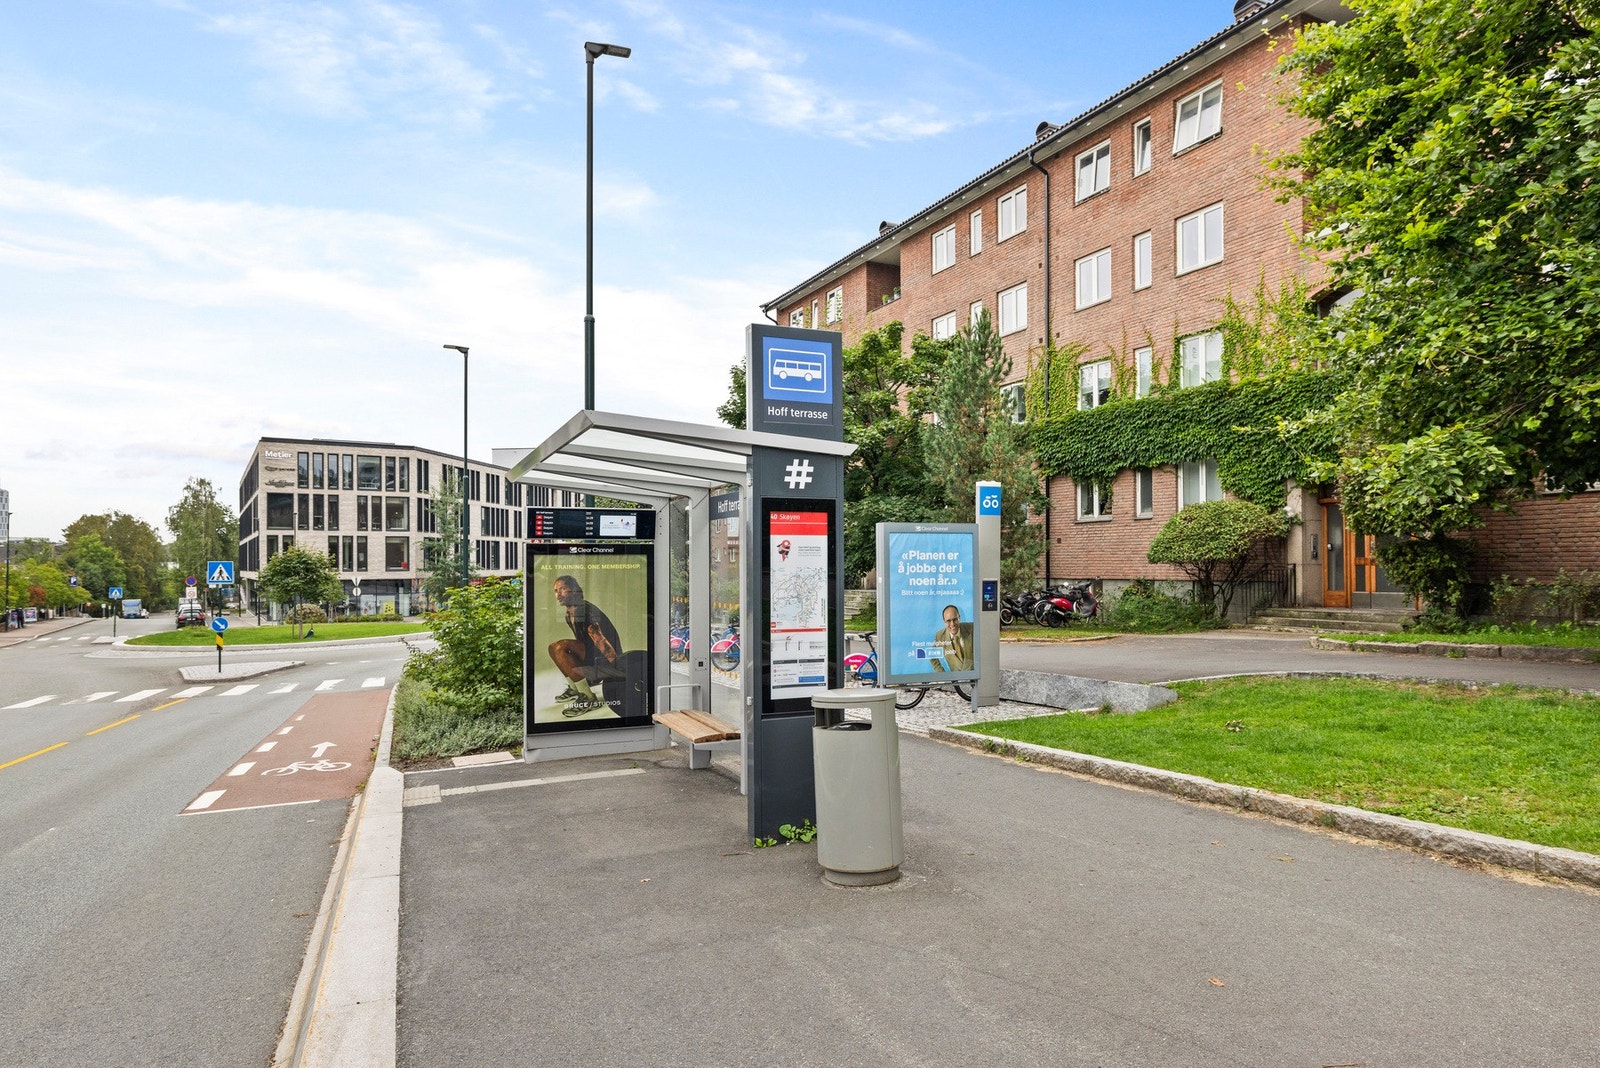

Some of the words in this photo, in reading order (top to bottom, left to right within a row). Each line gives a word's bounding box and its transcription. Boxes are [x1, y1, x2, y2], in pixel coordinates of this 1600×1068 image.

[767, 406, 788, 416] Hoff
[790, 408, 828, 419] terrasse
[265, 450, 292, 458] Metier
[717, 500, 729, 513] Hoff
[902, 550, 945, 560] «Planen
[947, 552, 959, 560] er
[898, 561, 904, 573] å
[906, 563, 936, 575] jobbe
[939, 563, 957, 573] der
[959, 563, 962, 573] i
[909, 577, 936, 585] noen
[937, 574, 958, 586] år.»
